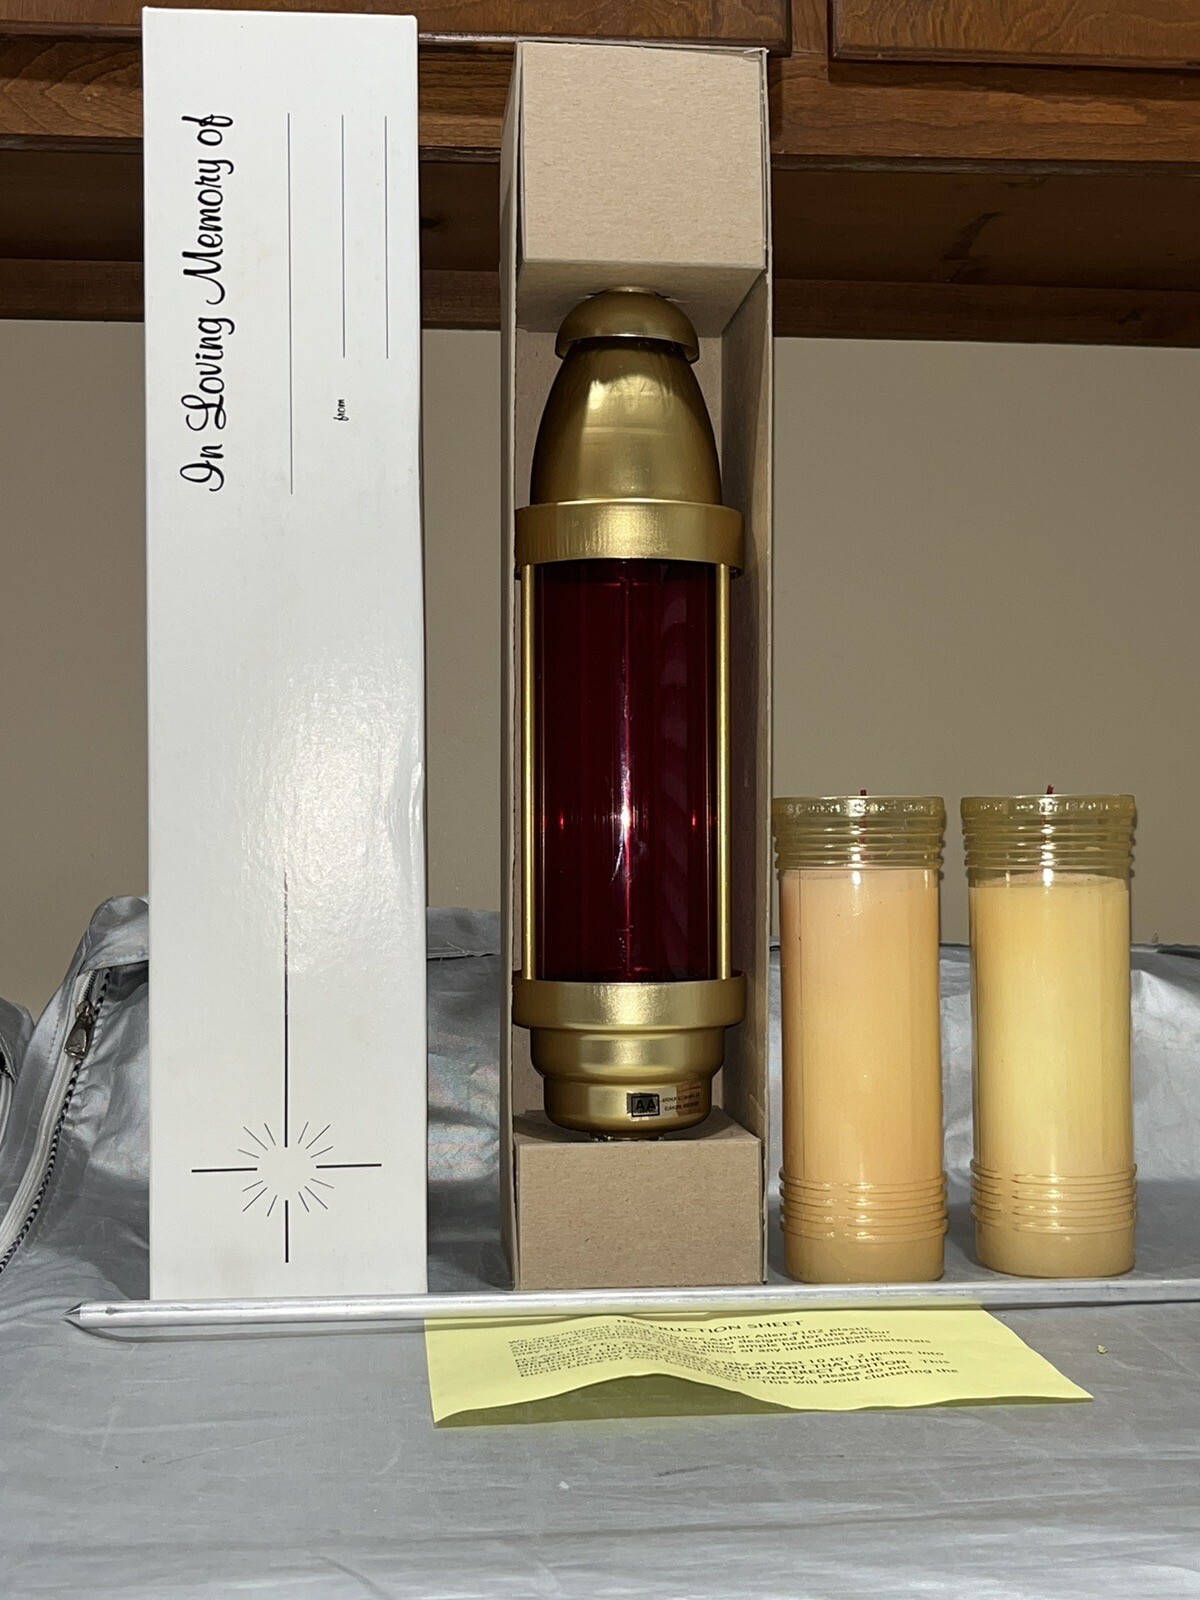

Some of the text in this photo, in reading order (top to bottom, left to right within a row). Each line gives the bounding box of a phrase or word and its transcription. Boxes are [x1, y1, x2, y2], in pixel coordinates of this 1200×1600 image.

[179, 114, 235, 492] In Loving Memory of
[333, 398, 349, 422] from
[747, 1320, 803, 1329] SHEET
[739, 1336, 797, 1344] designed
[785, 1340, 866, 1351] inflammable
[823, 1376, 859, 1384] avoid
[864, 1369, 932, 1380] cluttering
